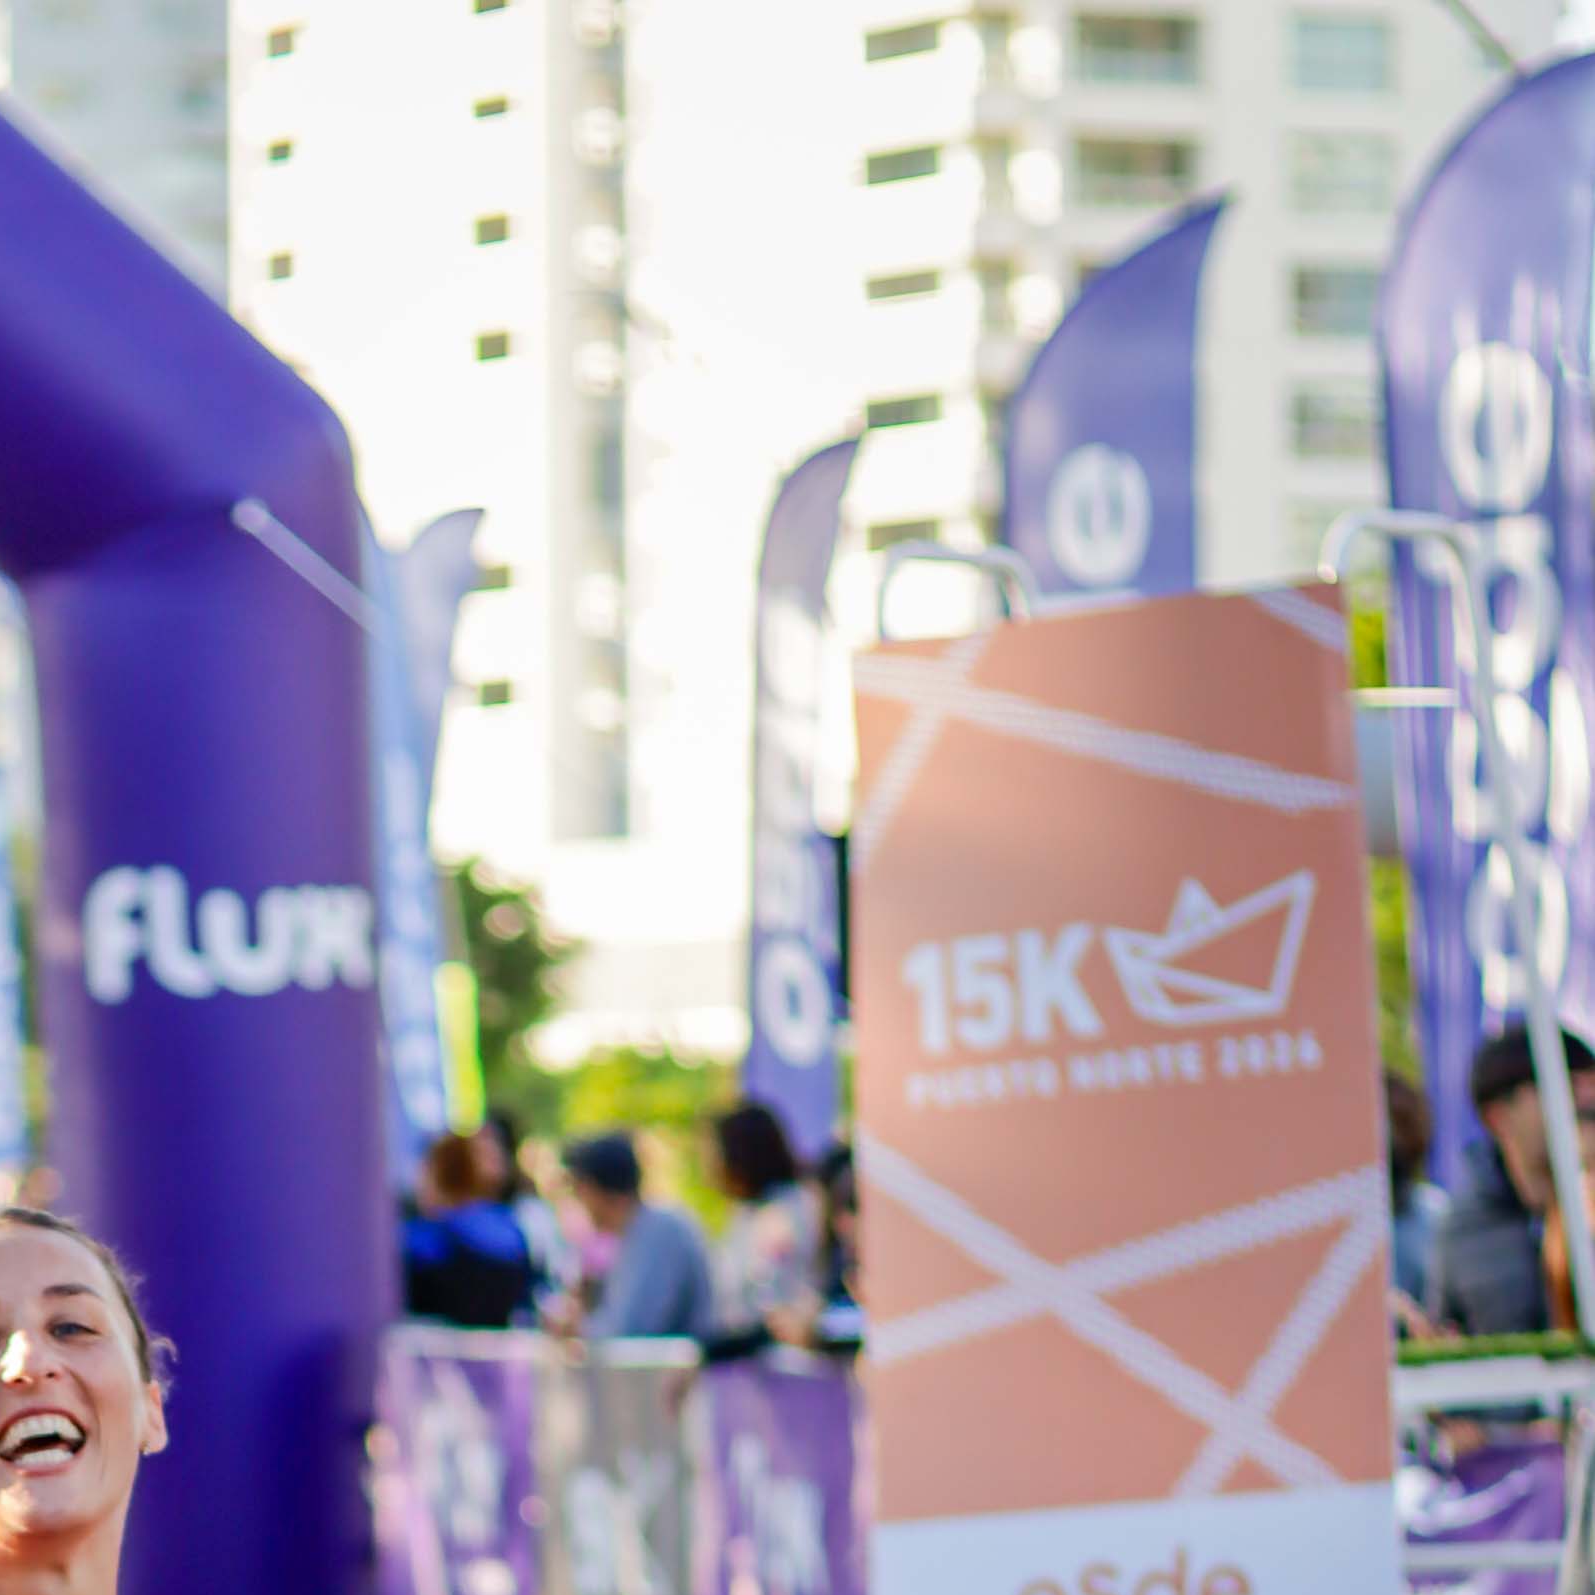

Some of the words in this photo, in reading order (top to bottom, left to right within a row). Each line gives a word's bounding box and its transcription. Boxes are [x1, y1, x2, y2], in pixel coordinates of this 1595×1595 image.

[902, 921, 1103, 1055] 15K
[906, 1056, 1060, 1110] PUERTO
[1068, 1040, 1203, 1092] NORTE
